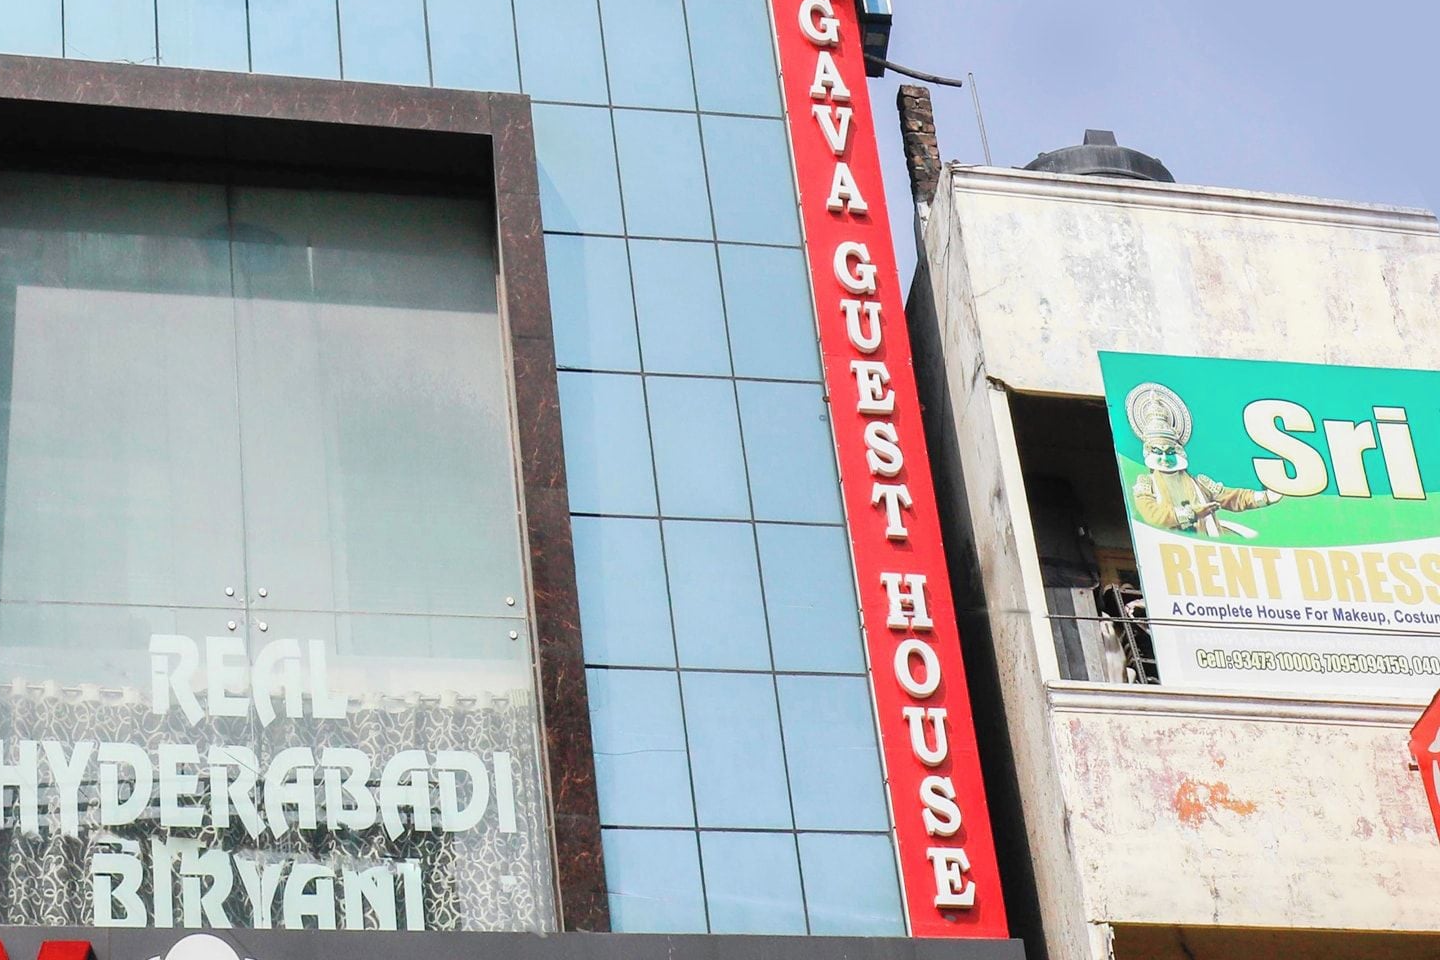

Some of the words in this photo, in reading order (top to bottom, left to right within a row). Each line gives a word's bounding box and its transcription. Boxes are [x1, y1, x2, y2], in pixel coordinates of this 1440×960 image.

[1242, 397, 1428, 501] Sri
[832, 241, 912, 540] GUEST
[879, 572, 976, 910] HOUSE
[1158, 542, 1283, 600] RENT
[1293, 549, 1440, 606] DRESS
[1172, 602, 1183, 616] A
[1186, 602, 1253, 620] Complete
[1256, 605, 1301, 620] House
[1306, 607, 1328, 621] For
[1332, 607, 1391, 626] Makeup,
[148, 634, 348, 727] REAL
[91, 836, 425, 931] BIRYANI
